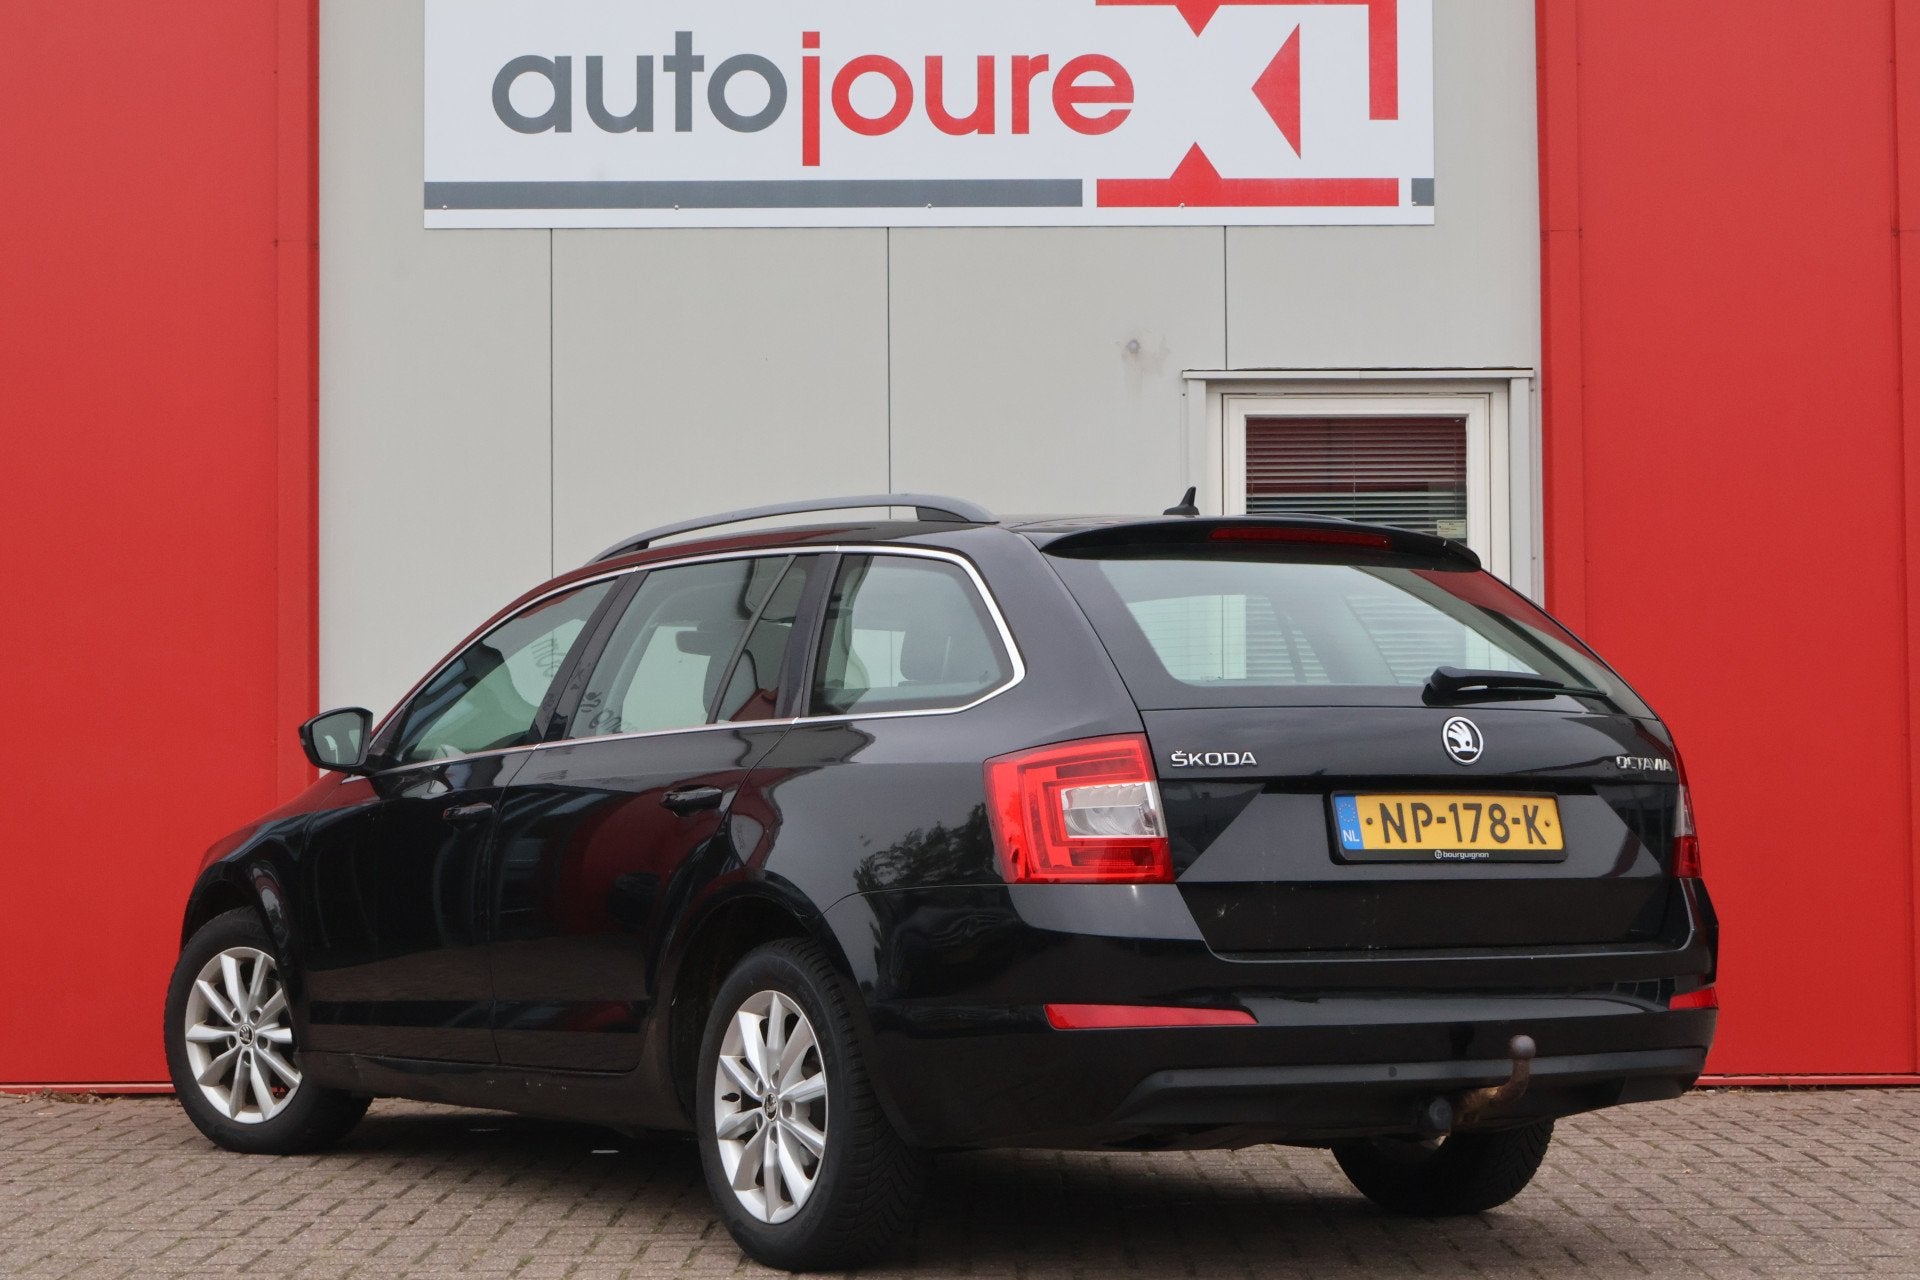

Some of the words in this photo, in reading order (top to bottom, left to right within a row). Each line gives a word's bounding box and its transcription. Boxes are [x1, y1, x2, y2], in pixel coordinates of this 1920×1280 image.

[491, 30, 1135, 166] autojoure
[1171, 750, 1257, 767] ŠKODA
[1616, 756, 1672, 771] OCTAVIA
[1379, 802, 1547, 844] NP-178-K
[1342, 829, 1360, 842] NL
[1442, 851, 1490, 859] bourguignon
